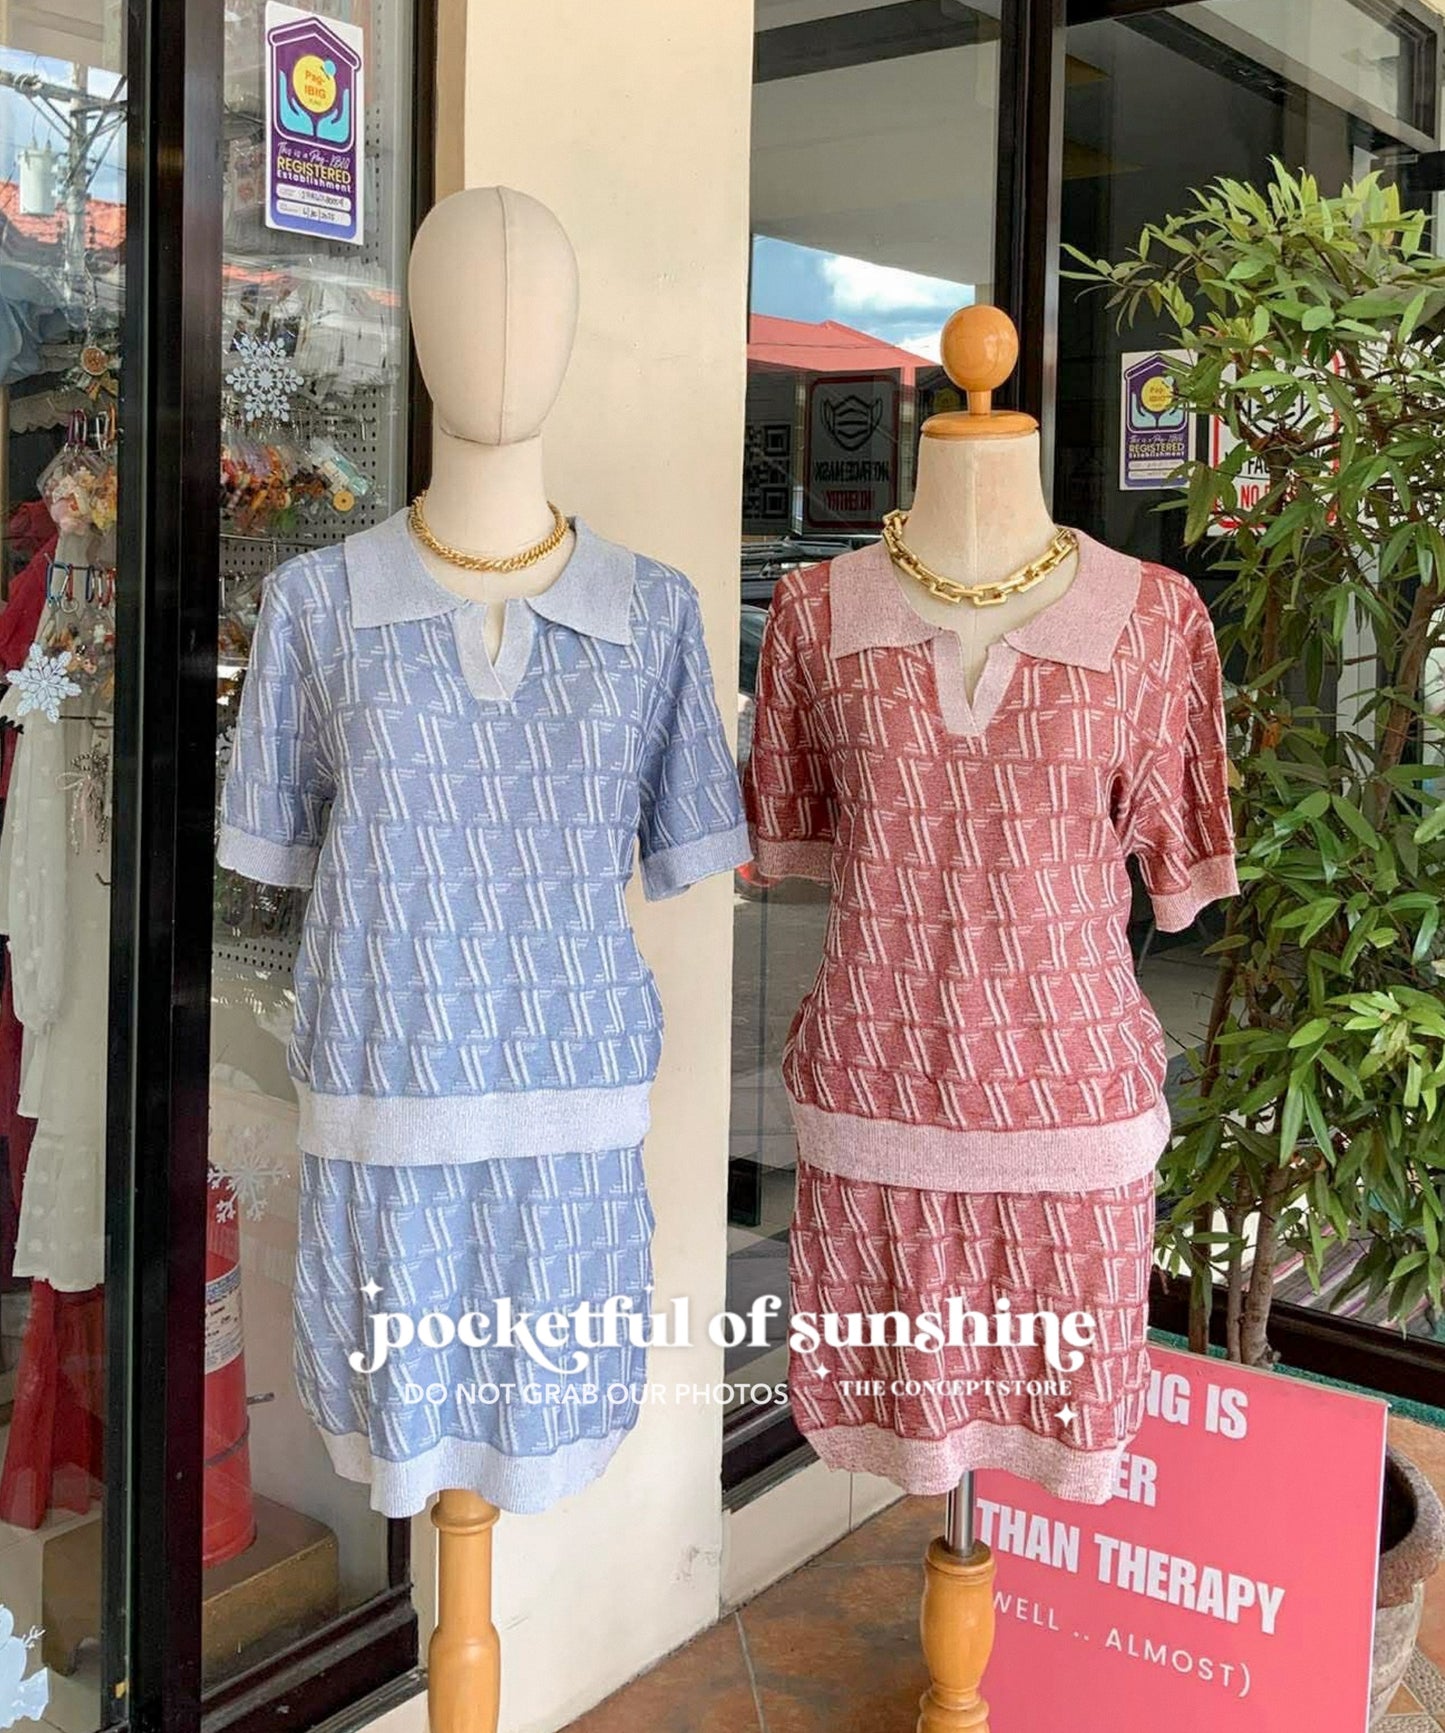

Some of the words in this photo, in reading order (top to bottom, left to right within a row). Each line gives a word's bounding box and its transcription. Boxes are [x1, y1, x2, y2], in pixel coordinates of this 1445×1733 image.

[276, 169, 352, 193] Establishment
[277, 156, 351, 184] REGISTERED
[1129, 442, 1185, 453] REGISTERED
[1241, 484, 1259, 508] NO
[1205, 1383, 1249, 1440] IS
[976, 1497, 1080, 1574] THAN
[1094, 1533, 1285, 1636] THERAPY
[993, 1590, 1060, 1632] WELL
[1105, 1628, 1251, 1699] ALMOST)
